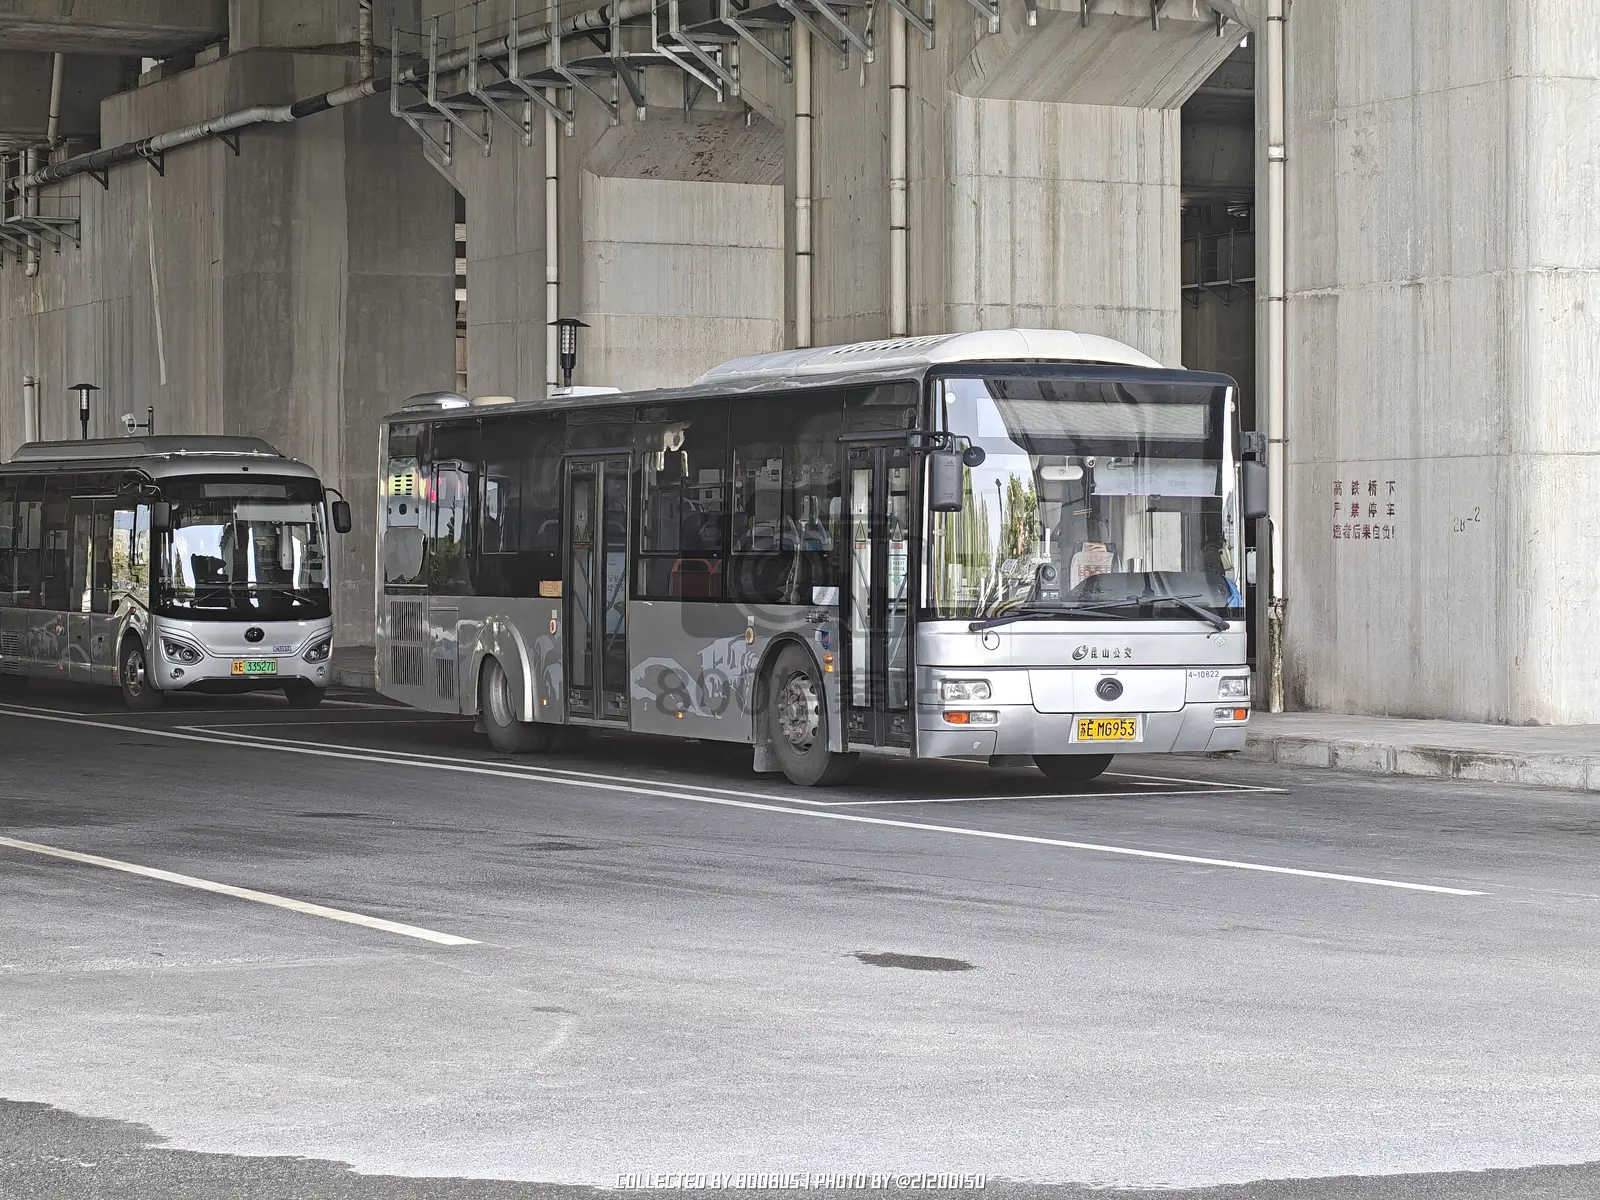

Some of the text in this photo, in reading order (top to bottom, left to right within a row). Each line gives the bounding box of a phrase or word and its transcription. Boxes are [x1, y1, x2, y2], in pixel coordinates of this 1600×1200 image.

[1333, 480, 1396, 496] 高铁桥下
[1333, 502, 1396, 518] 严禁停车
[1091, 646, 1132, 659] 昆山公交
[1188, 670, 1220, 679] 4-10822
